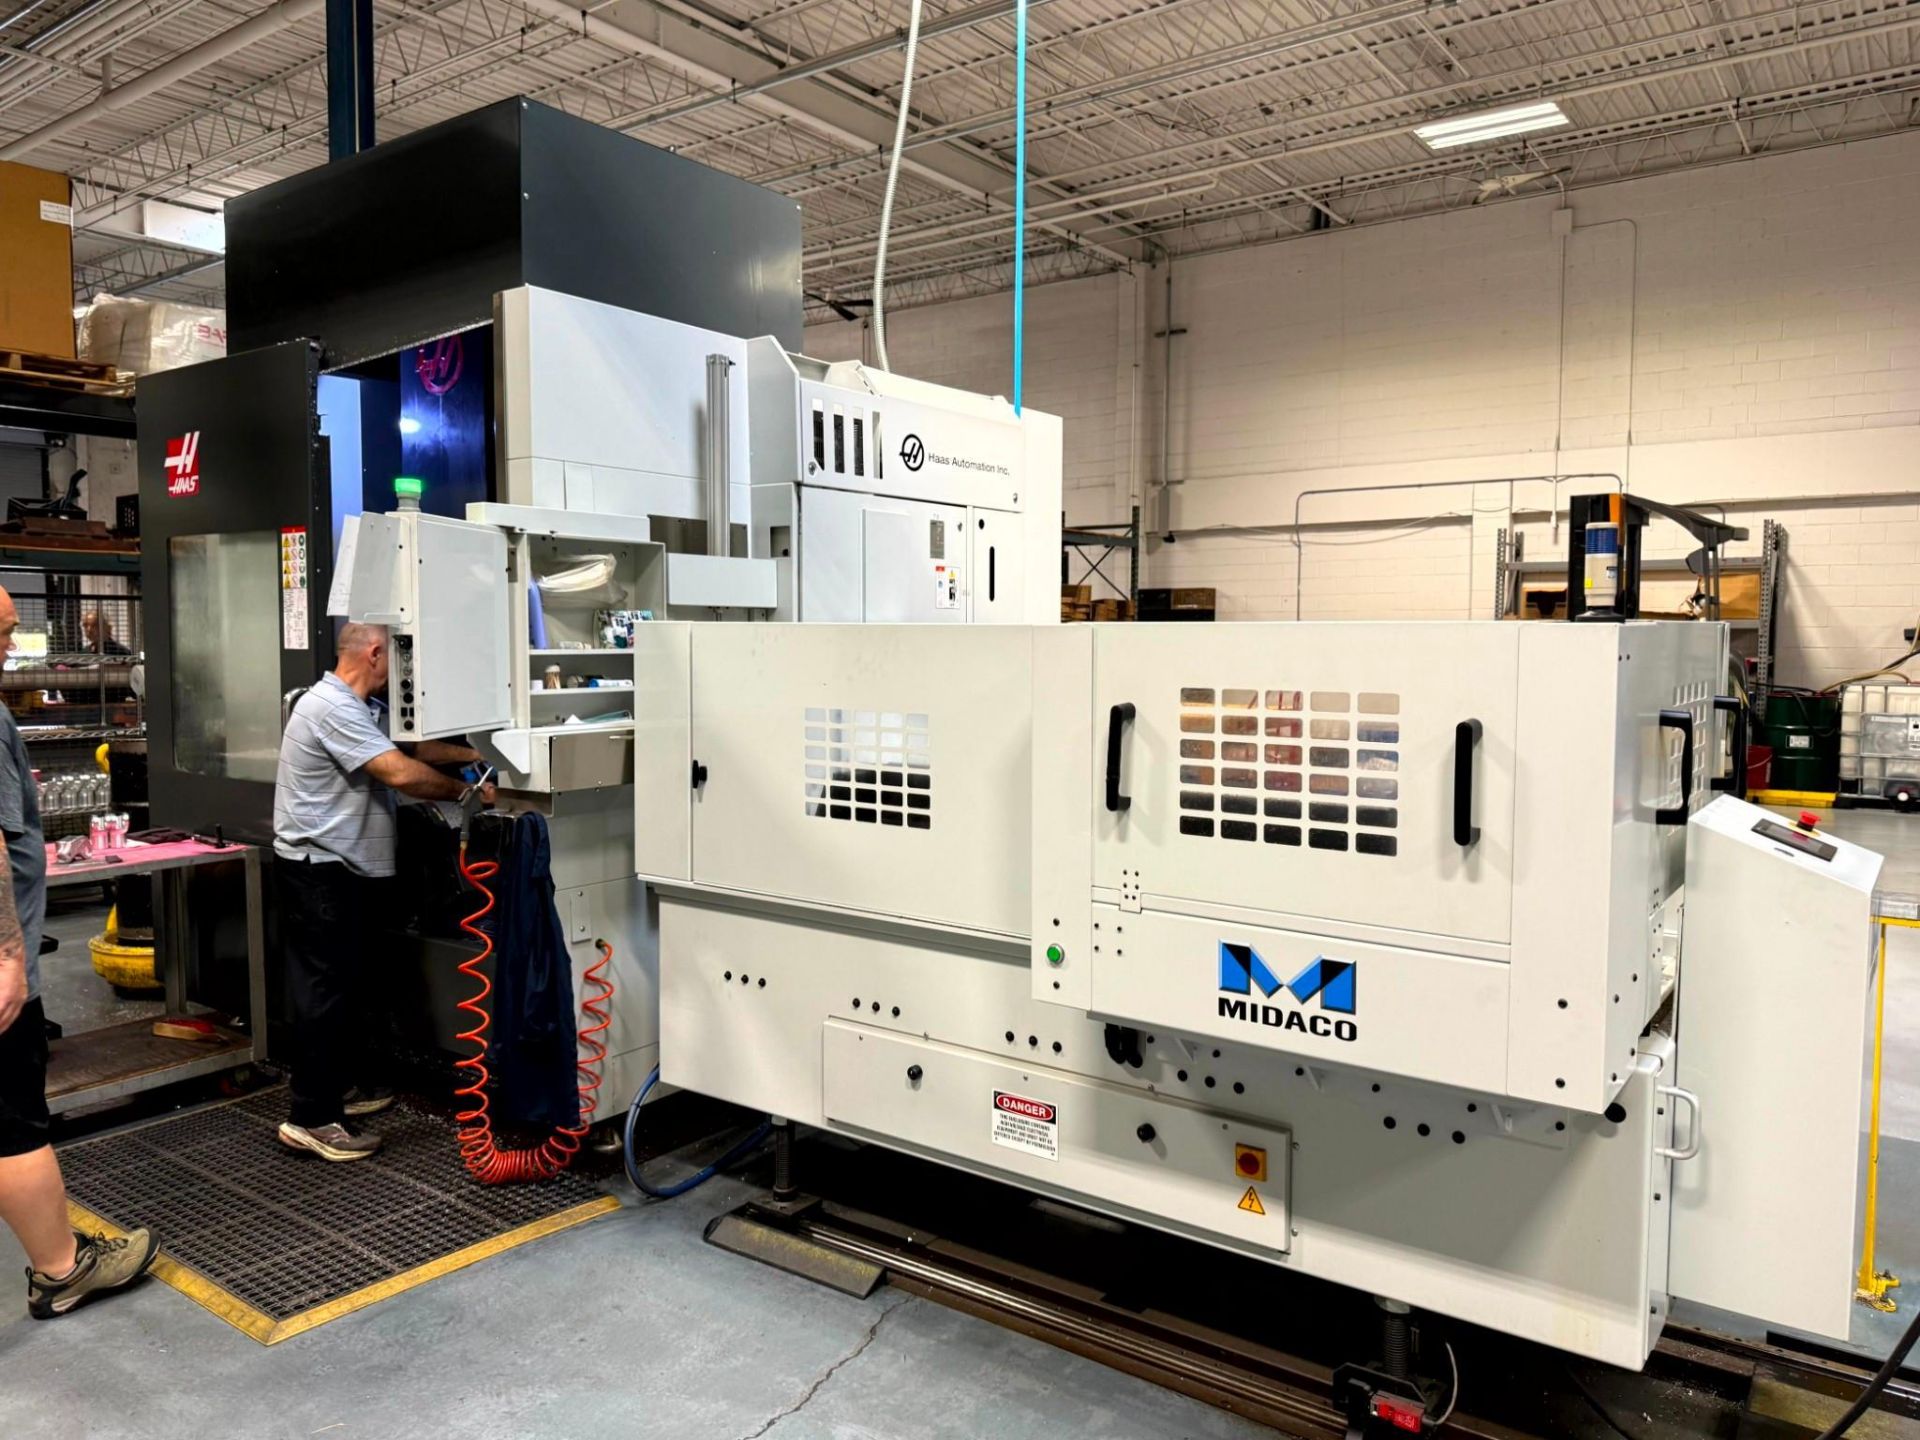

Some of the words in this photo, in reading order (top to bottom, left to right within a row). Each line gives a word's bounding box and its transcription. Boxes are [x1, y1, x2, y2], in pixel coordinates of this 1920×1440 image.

[928, 453, 950, 465] Haas
[952, 457, 995, 472] Automation
[997, 465, 1010, 476] Inc.
[1218, 997, 1358, 1042] MIDACO
[1003, 1098, 1046, 1117] DANGER
